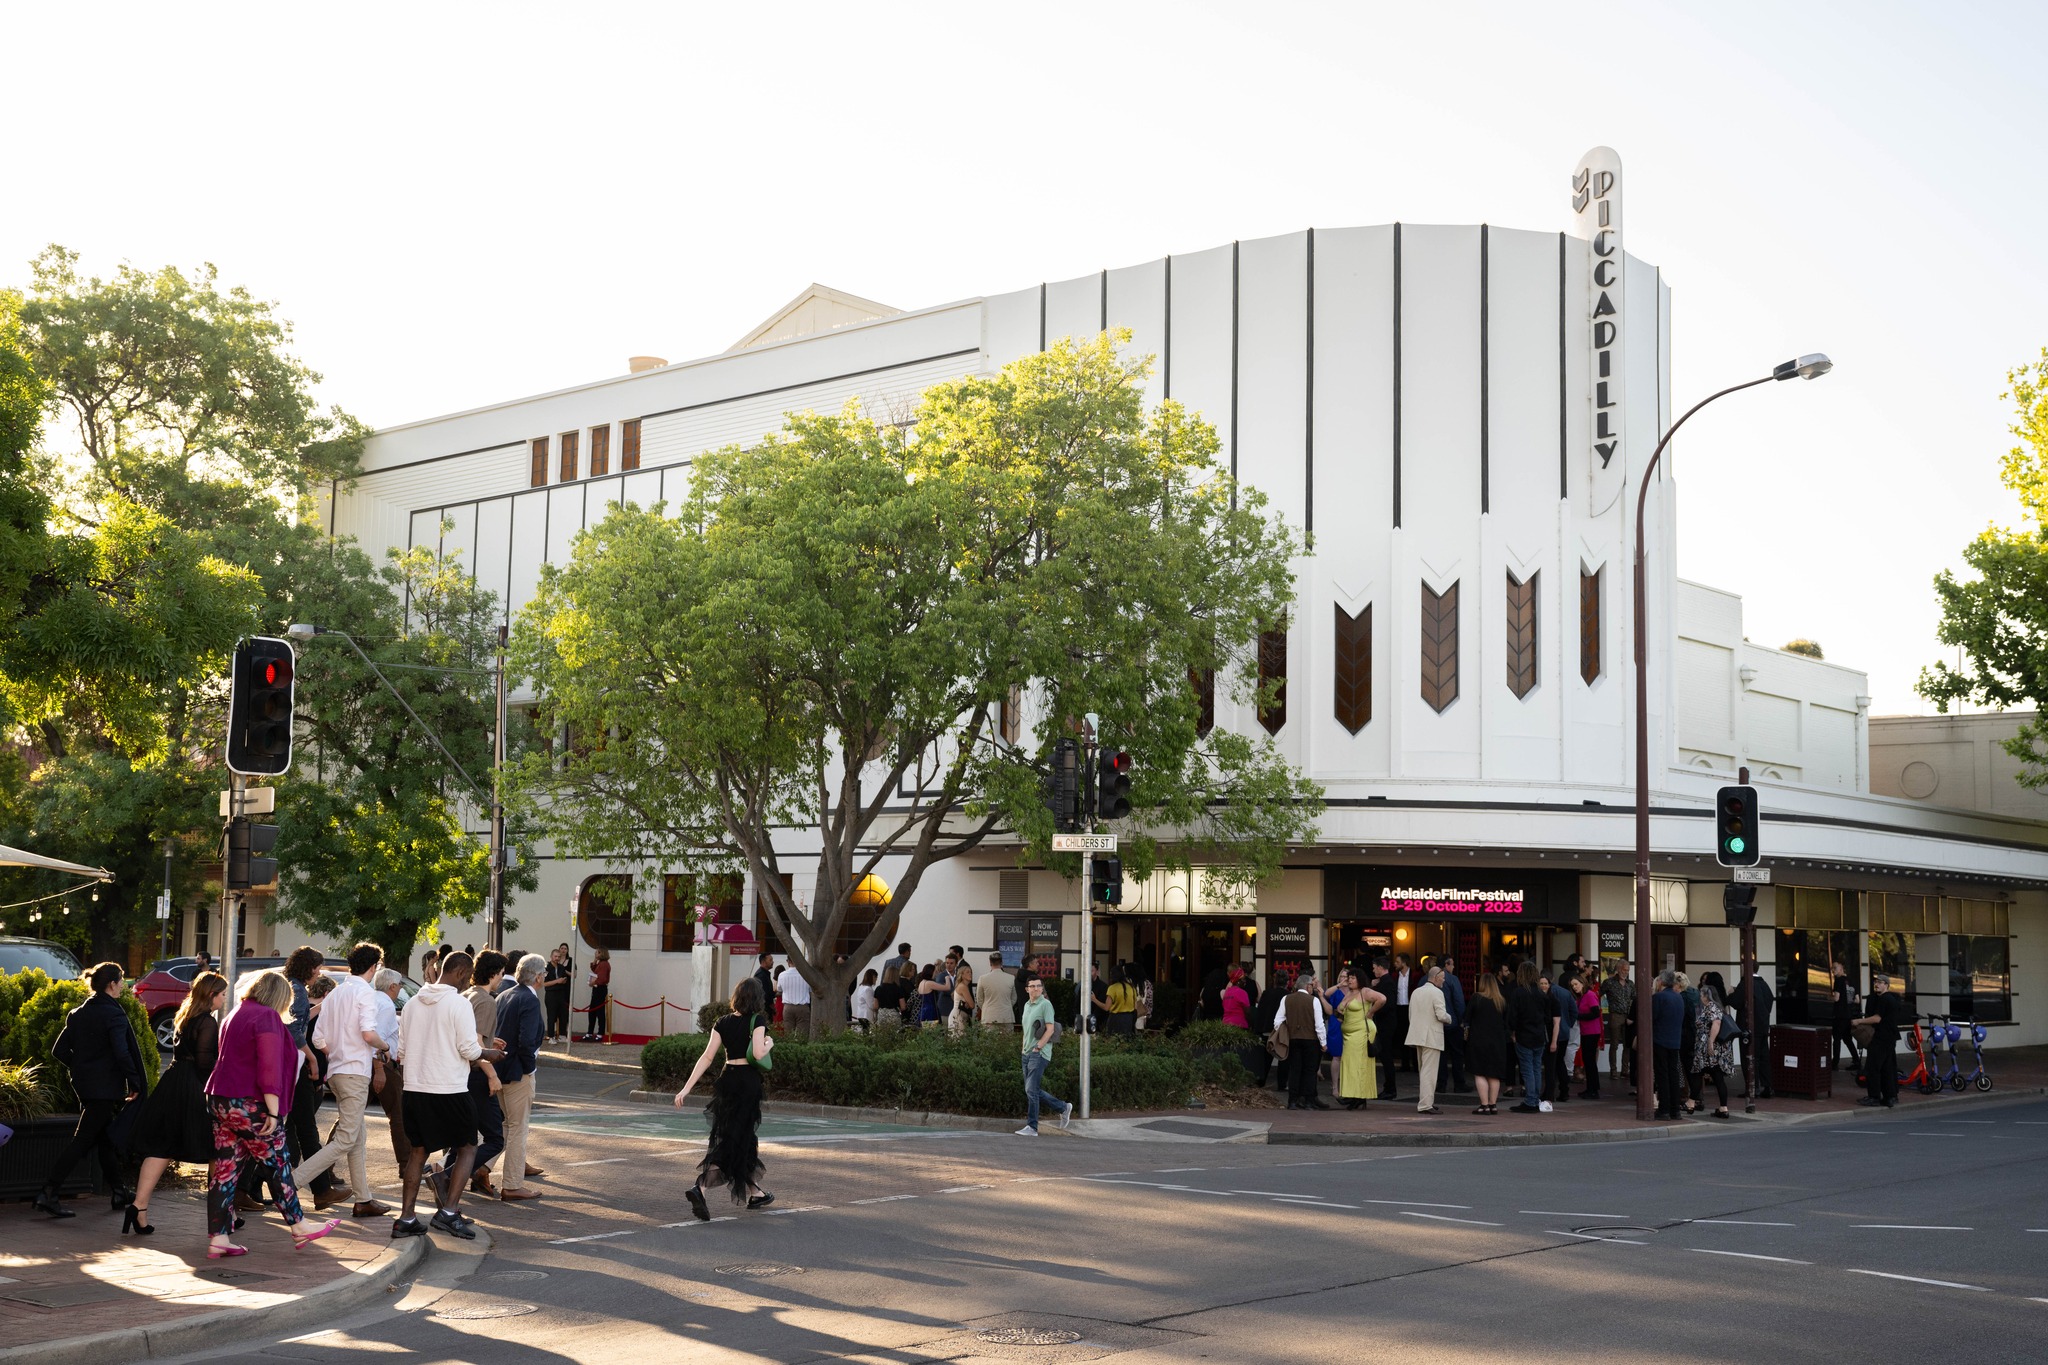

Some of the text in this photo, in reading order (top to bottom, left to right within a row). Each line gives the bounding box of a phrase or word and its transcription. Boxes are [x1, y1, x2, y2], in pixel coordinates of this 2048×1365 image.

[1593, 170, 1618, 470] PICCADILLY
[1065, 837, 1110, 848] CHILDERS ST
[1381, 887, 1524, 901] AdelaideFilmFestival
[1425, 900, 1482, 912] October
[1484, 901, 1523, 913] 2023
[1030, 929, 1058, 937] SHOWING
[1278, 926, 1297, 934] NOW
[1270, 934, 1306, 942] SHOWING
[1605, 940, 1621, 948] SOON
